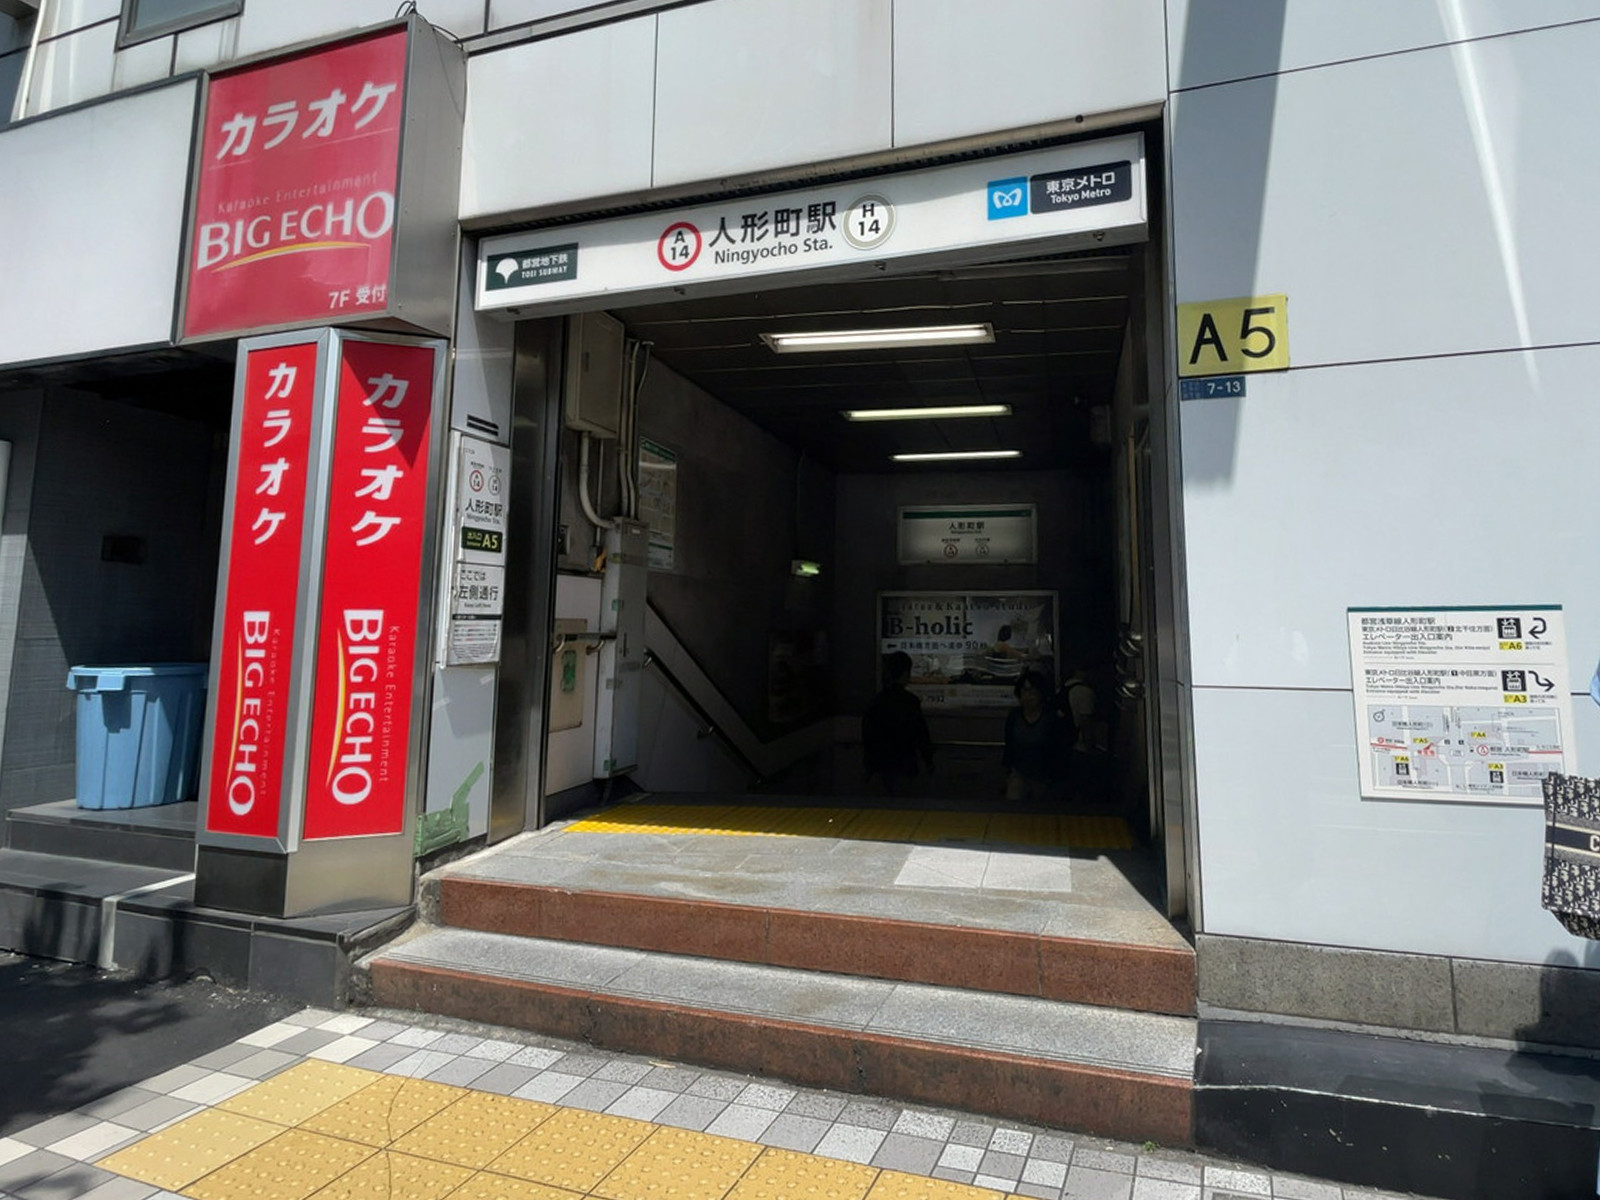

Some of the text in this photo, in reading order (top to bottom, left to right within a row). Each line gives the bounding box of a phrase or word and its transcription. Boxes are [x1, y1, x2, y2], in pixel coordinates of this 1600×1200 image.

[216, 82, 396, 160] カラオケ
[218, 171, 378, 214] Karaoke Entertainment
[1046, 172, 1115, 193] 東京メトロ
[1051, 187, 1111, 204] Tokyo Metro
[862, 203, 875, 218] H
[197, 191, 394, 271] BIG ECHO
[708, 201, 836, 247] 人形町駅
[858, 220, 881, 236] 14
[674, 231, 685, 244] A
[670, 245, 690, 260] 14
[714, 238, 833, 264] Ningyocho Sta.
[539, 266, 568, 276] SUBWAY
[329, 284, 386, 309] 7F 受付
[1189, 307, 1275, 364] A5
[1207, 381, 1241, 395] 7-13
[252, 362, 297, 545] カラオケ
[351, 373, 409, 546] カラオケ
[465, 498, 502, 517] 人形町駅
[949, 521, 984, 530] 人形町駅
[482, 534, 498, 549] A5
[459, 585, 499, 601] 左側通行
[888, 615, 974, 635] B-holic
[1508, 642, 1523, 650] A6
[332, 609, 384, 805] BIG ECHO
[380, 625, 399, 782] Karaoke Entertainment
[1513, 695, 1527, 703] A3
[228, 611, 270, 816] BIG ECHO
